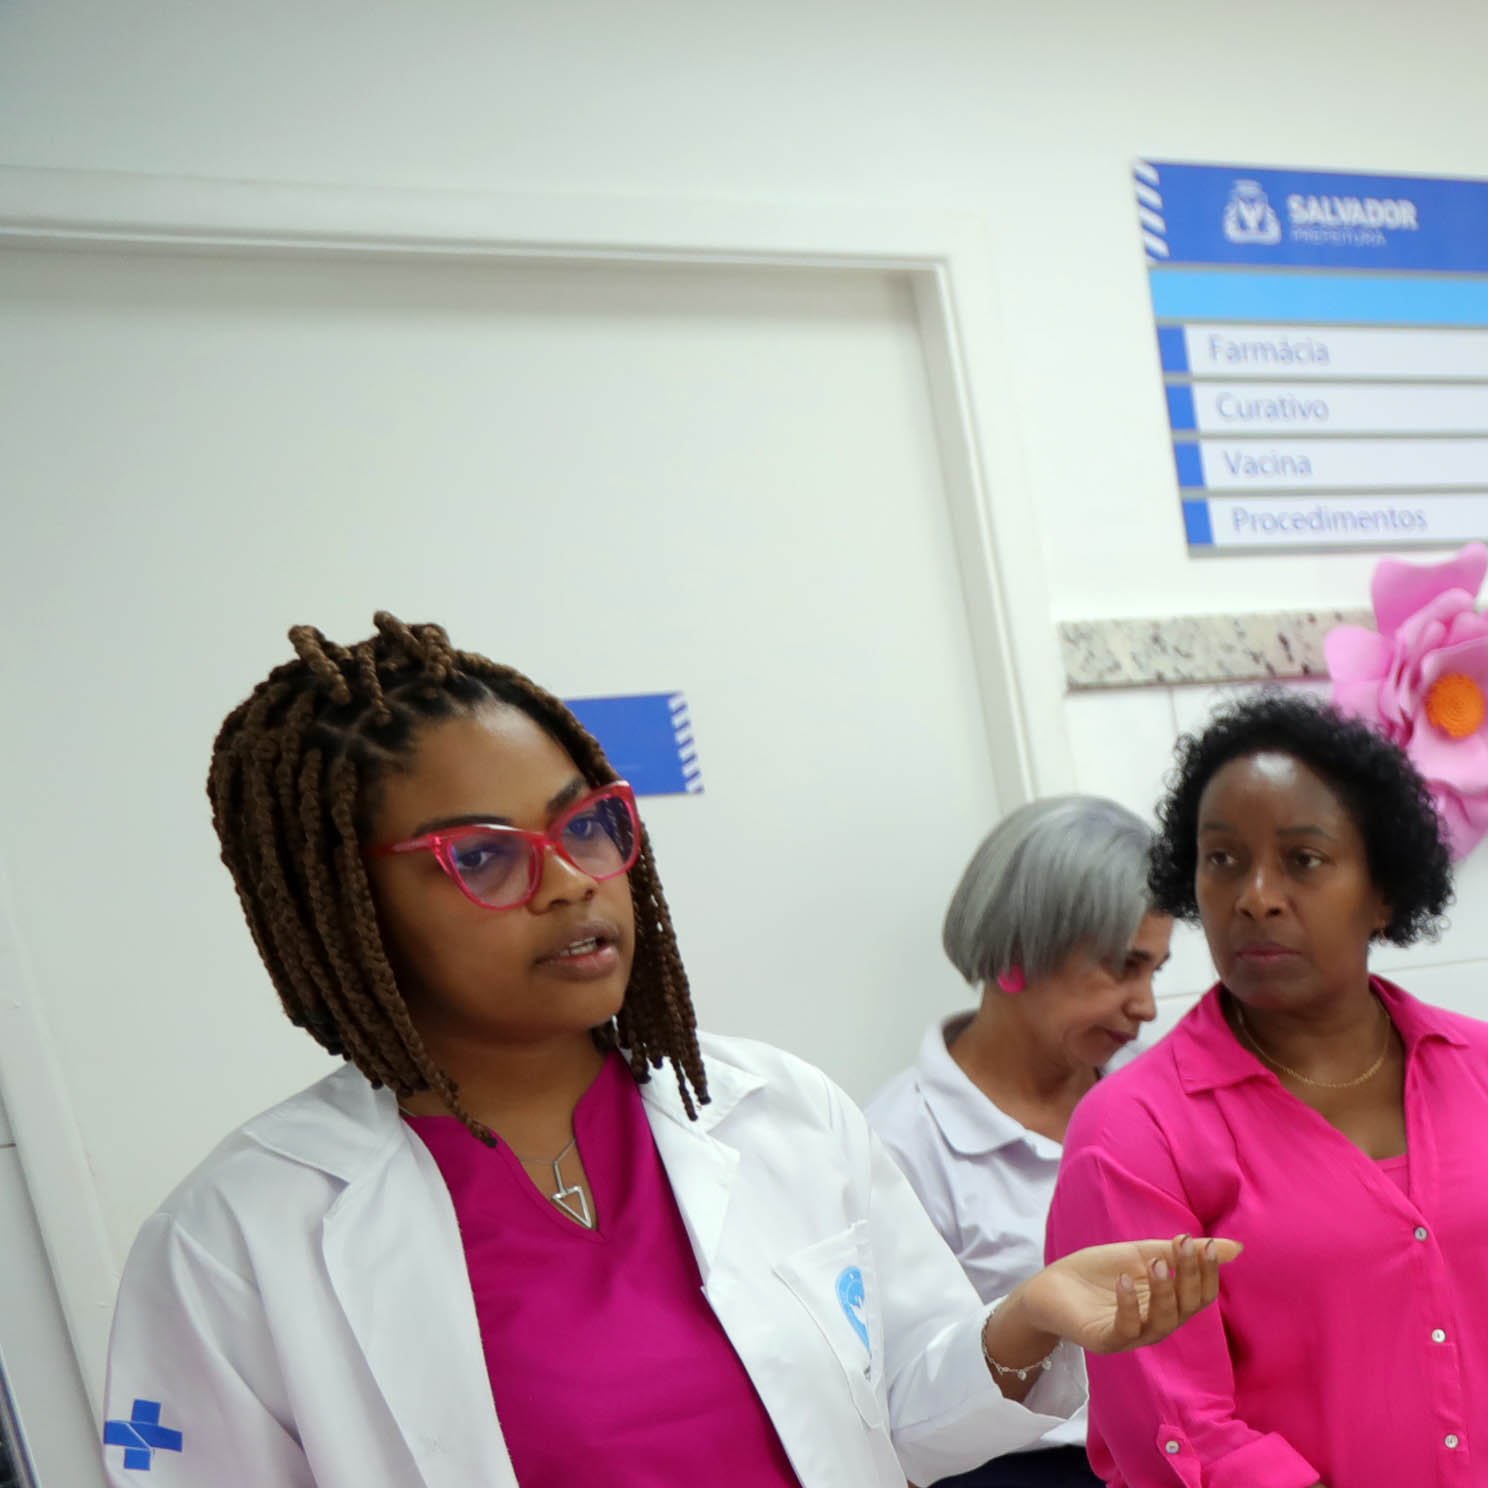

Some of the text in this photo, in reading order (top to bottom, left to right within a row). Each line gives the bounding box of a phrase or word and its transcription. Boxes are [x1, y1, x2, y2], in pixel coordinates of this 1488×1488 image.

[1286, 195, 1418, 231] SALVADOR
[1207, 333, 1330, 367] Farmácia
[1215, 392, 1329, 422] Curativo
[1223, 451, 1312, 478] Vacina
[1232, 504, 1428, 533] Procedimentos
